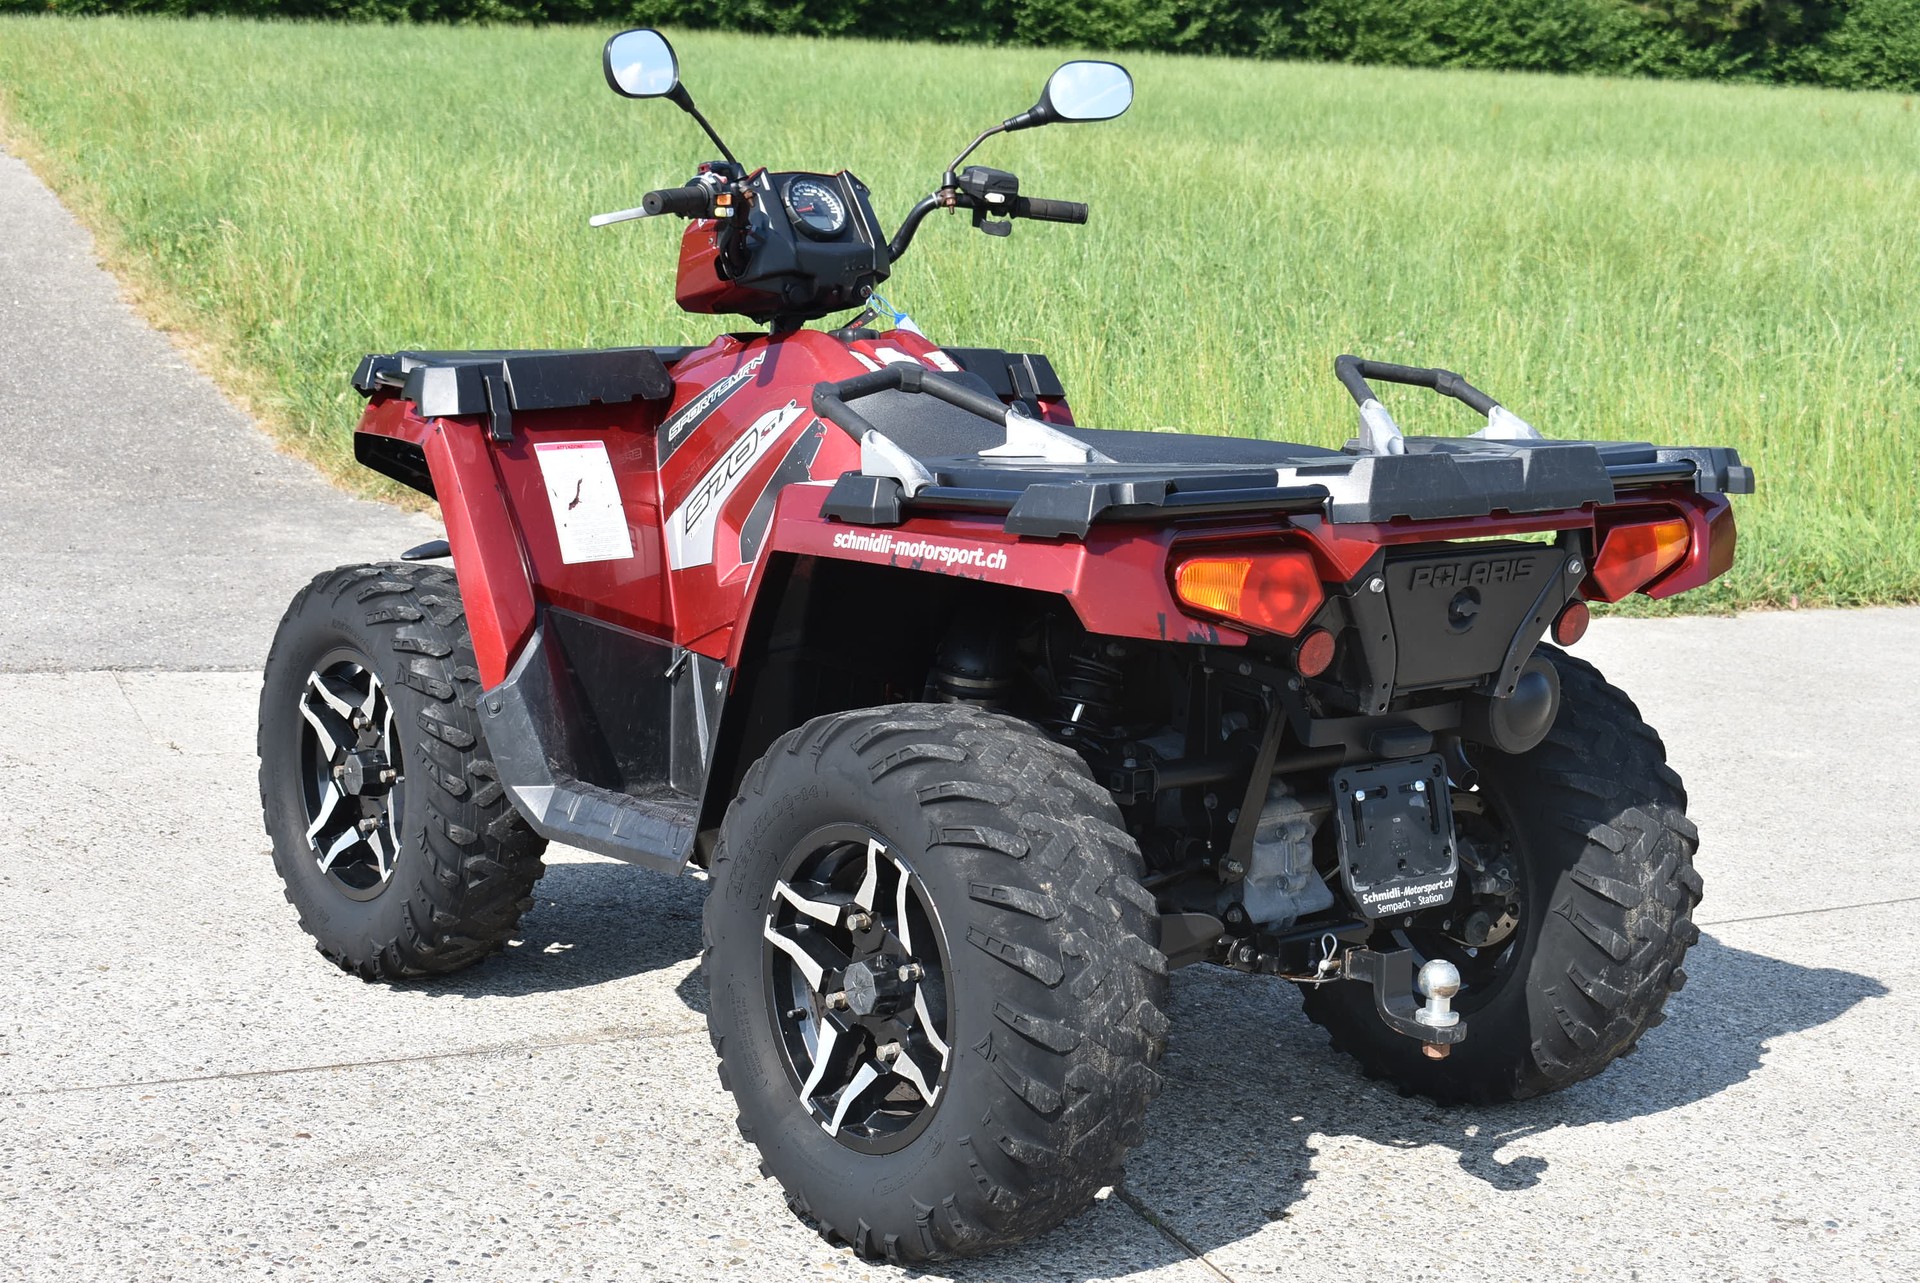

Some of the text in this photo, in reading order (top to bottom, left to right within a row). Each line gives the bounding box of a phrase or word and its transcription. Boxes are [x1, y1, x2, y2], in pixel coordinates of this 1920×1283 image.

[668, 350, 767, 442] SPORTSMAN
[684, 427, 759, 537] 570
[833, 531, 1007, 570] schmidli-motorsport.ch
[1408, 557, 1537, 591] POLARIS
[1362, 877, 1453, 904] Schmidli-Motorsport.ch
[1377, 898, 1411, 914] Sempach
[1417, 893, 1444, 906] Station
